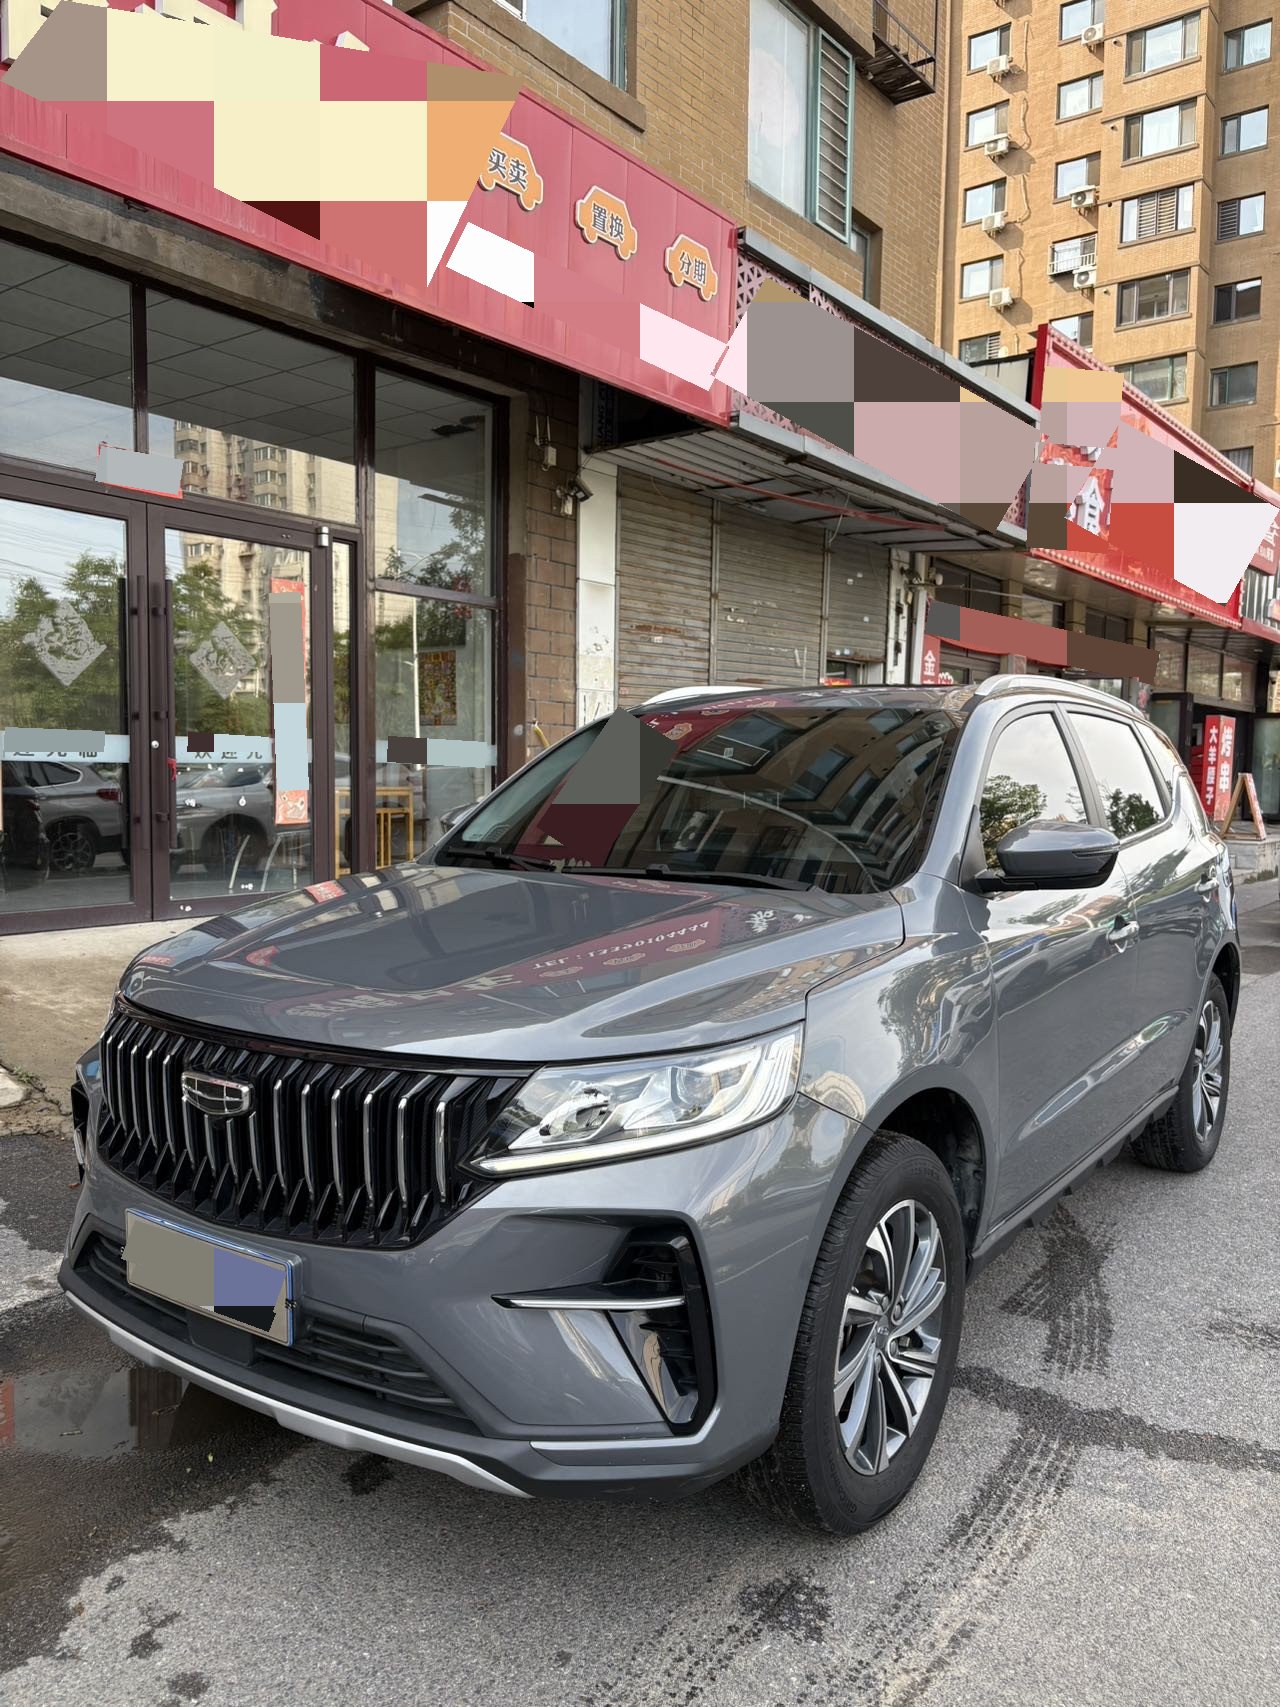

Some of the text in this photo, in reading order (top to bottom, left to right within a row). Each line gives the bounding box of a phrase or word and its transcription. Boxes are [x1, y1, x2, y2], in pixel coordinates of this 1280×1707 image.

[488, 148, 529, 190] 买卖
[591, 203, 625, 242] 置换
[679, 251, 707, 285] 分期
[1218, 725, 1233, 793] 烤串
